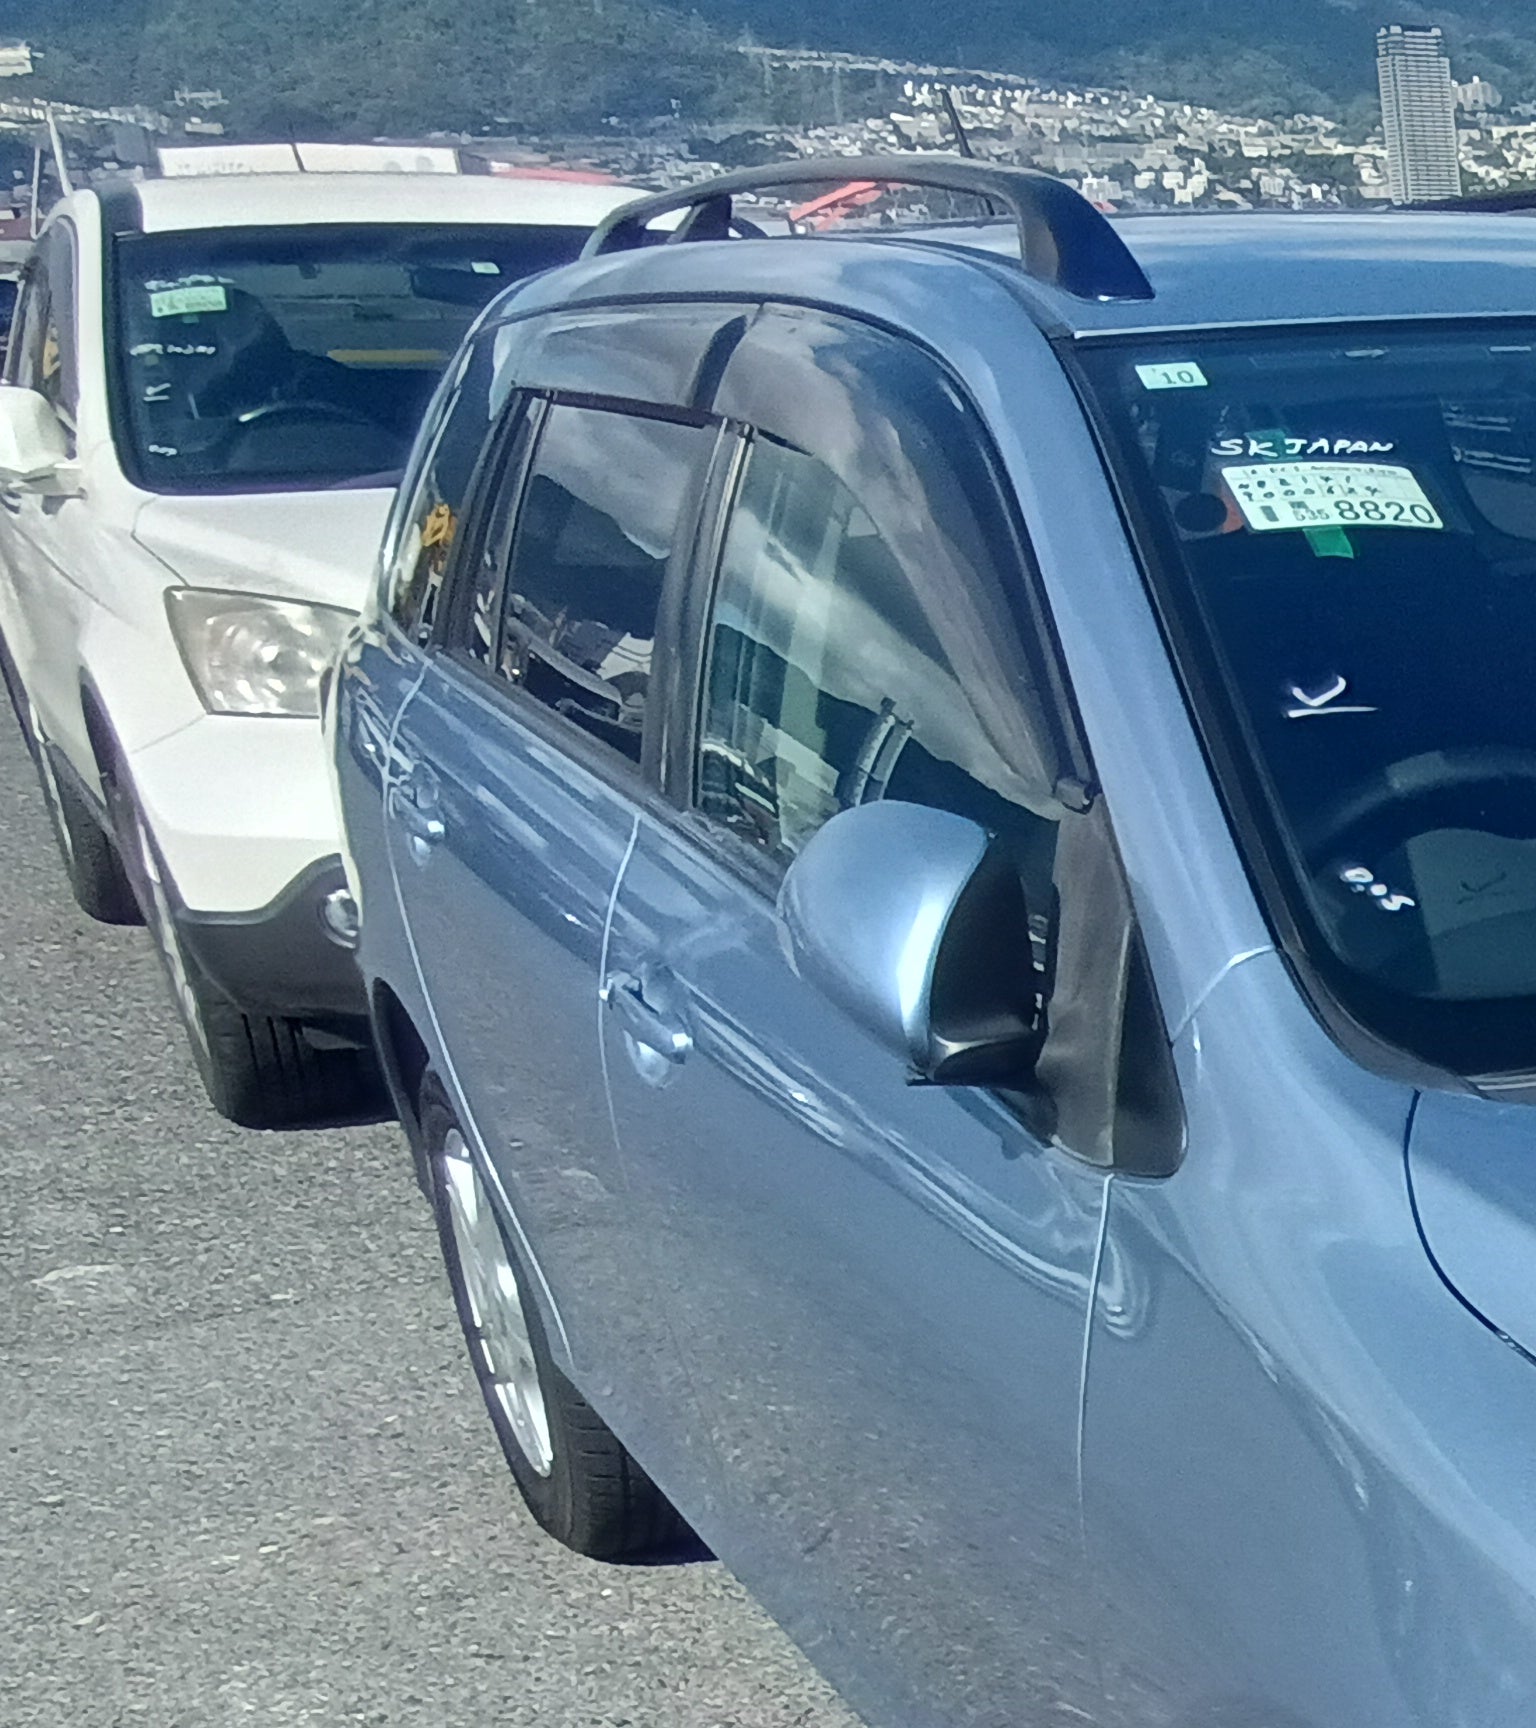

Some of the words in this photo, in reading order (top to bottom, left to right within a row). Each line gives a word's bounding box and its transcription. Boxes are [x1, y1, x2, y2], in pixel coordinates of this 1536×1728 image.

[1211, 438, 1279, 458] SK
[1284, 437, 1394, 455] JAPAN
[1333, 499, 1436, 525] 8820
